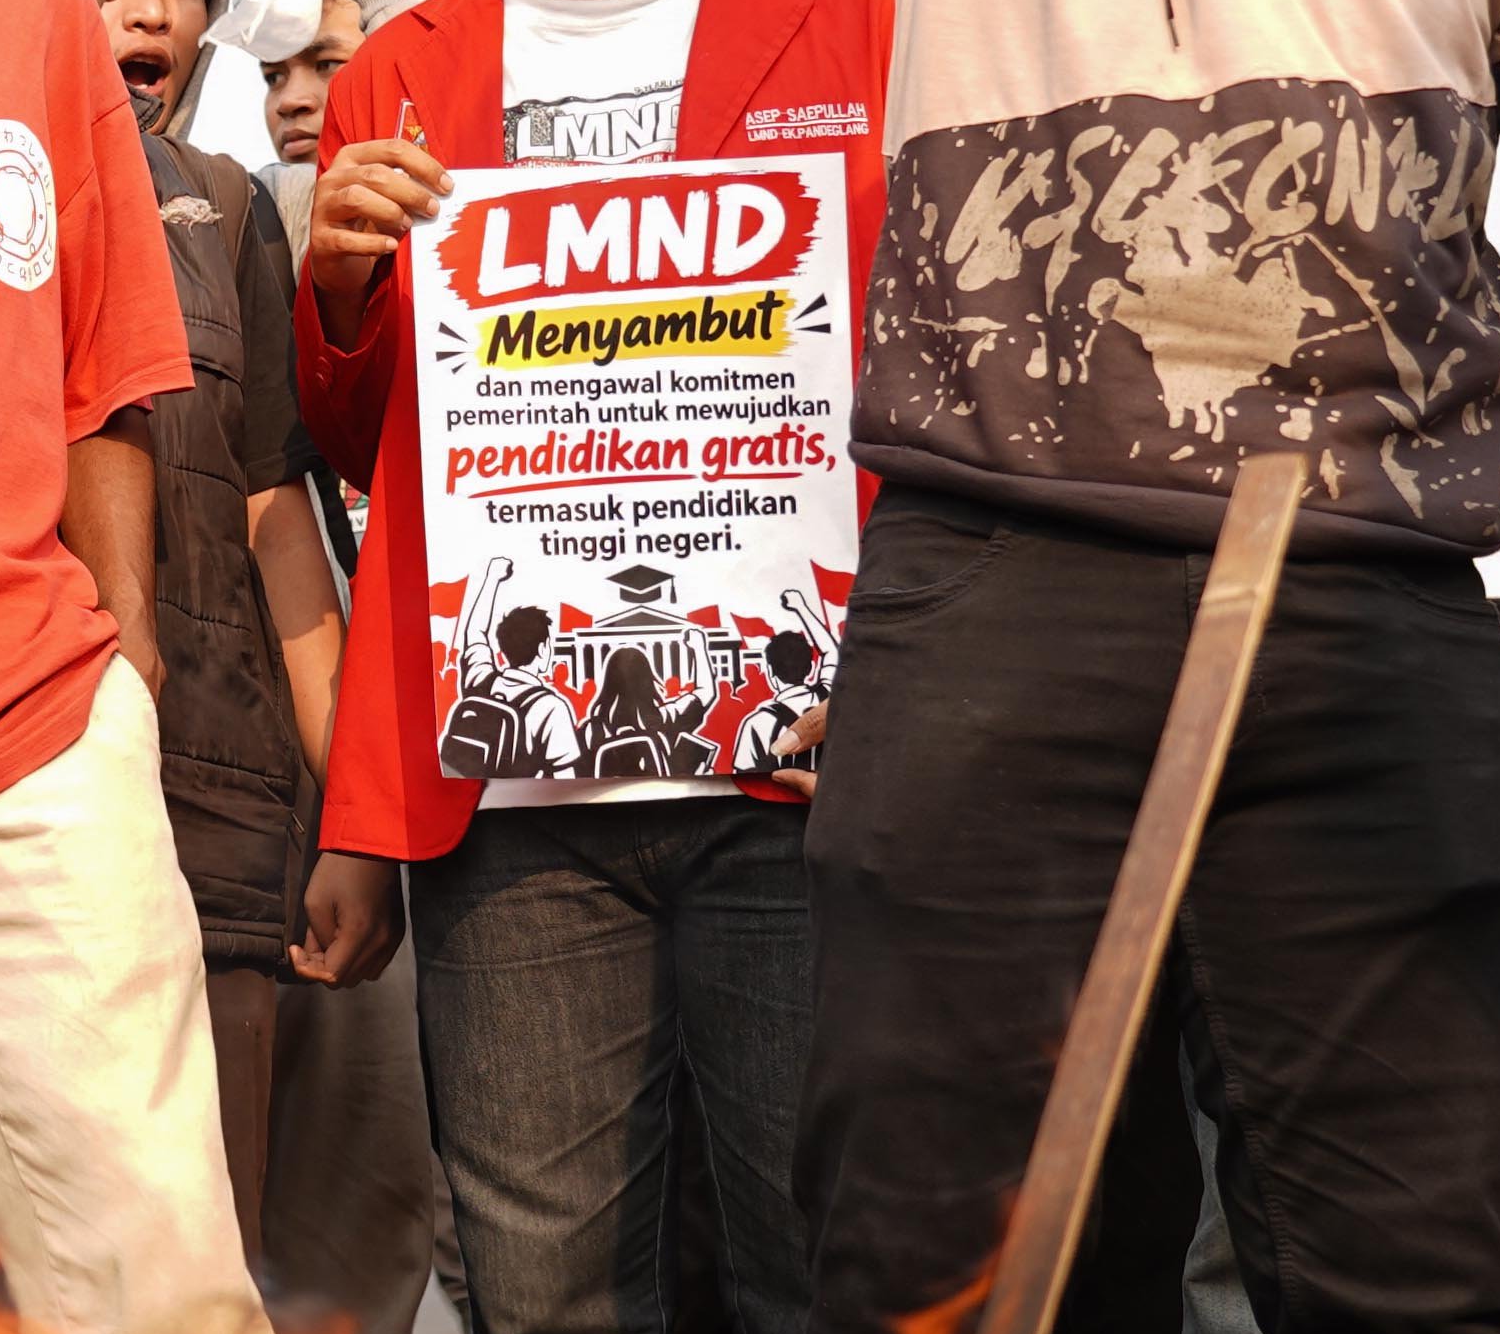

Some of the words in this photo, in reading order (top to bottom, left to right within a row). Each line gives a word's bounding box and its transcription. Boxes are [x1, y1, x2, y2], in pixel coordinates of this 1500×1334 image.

[745, 108, 781, 126] ASEP
[786, 102, 867, 122] SAEPULLAH
[747, 128, 778, 142] LMND
[477, 183, 786, 297] LMND
[486, 289, 787, 366] Menyambut
[476, 374, 522, 397] dan
[530, 370, 662, 401] mengawal
[669, 368, 795, 393] komitmen
[446, 400, 590, 431] pemerintah
[597, 399, 669, 423] untuk
[675, 394, 831, 424] mewujudkan
[446, 428, 688, 495] pendidikan
[701, 422, 836, 483] gratis,
[486, 493, 624, 524] termasuk
[632, 488, 798, 527] pendidikan
[539, 527, 627, 561] tinggi
[635, 523, 742, 560] negeri.
